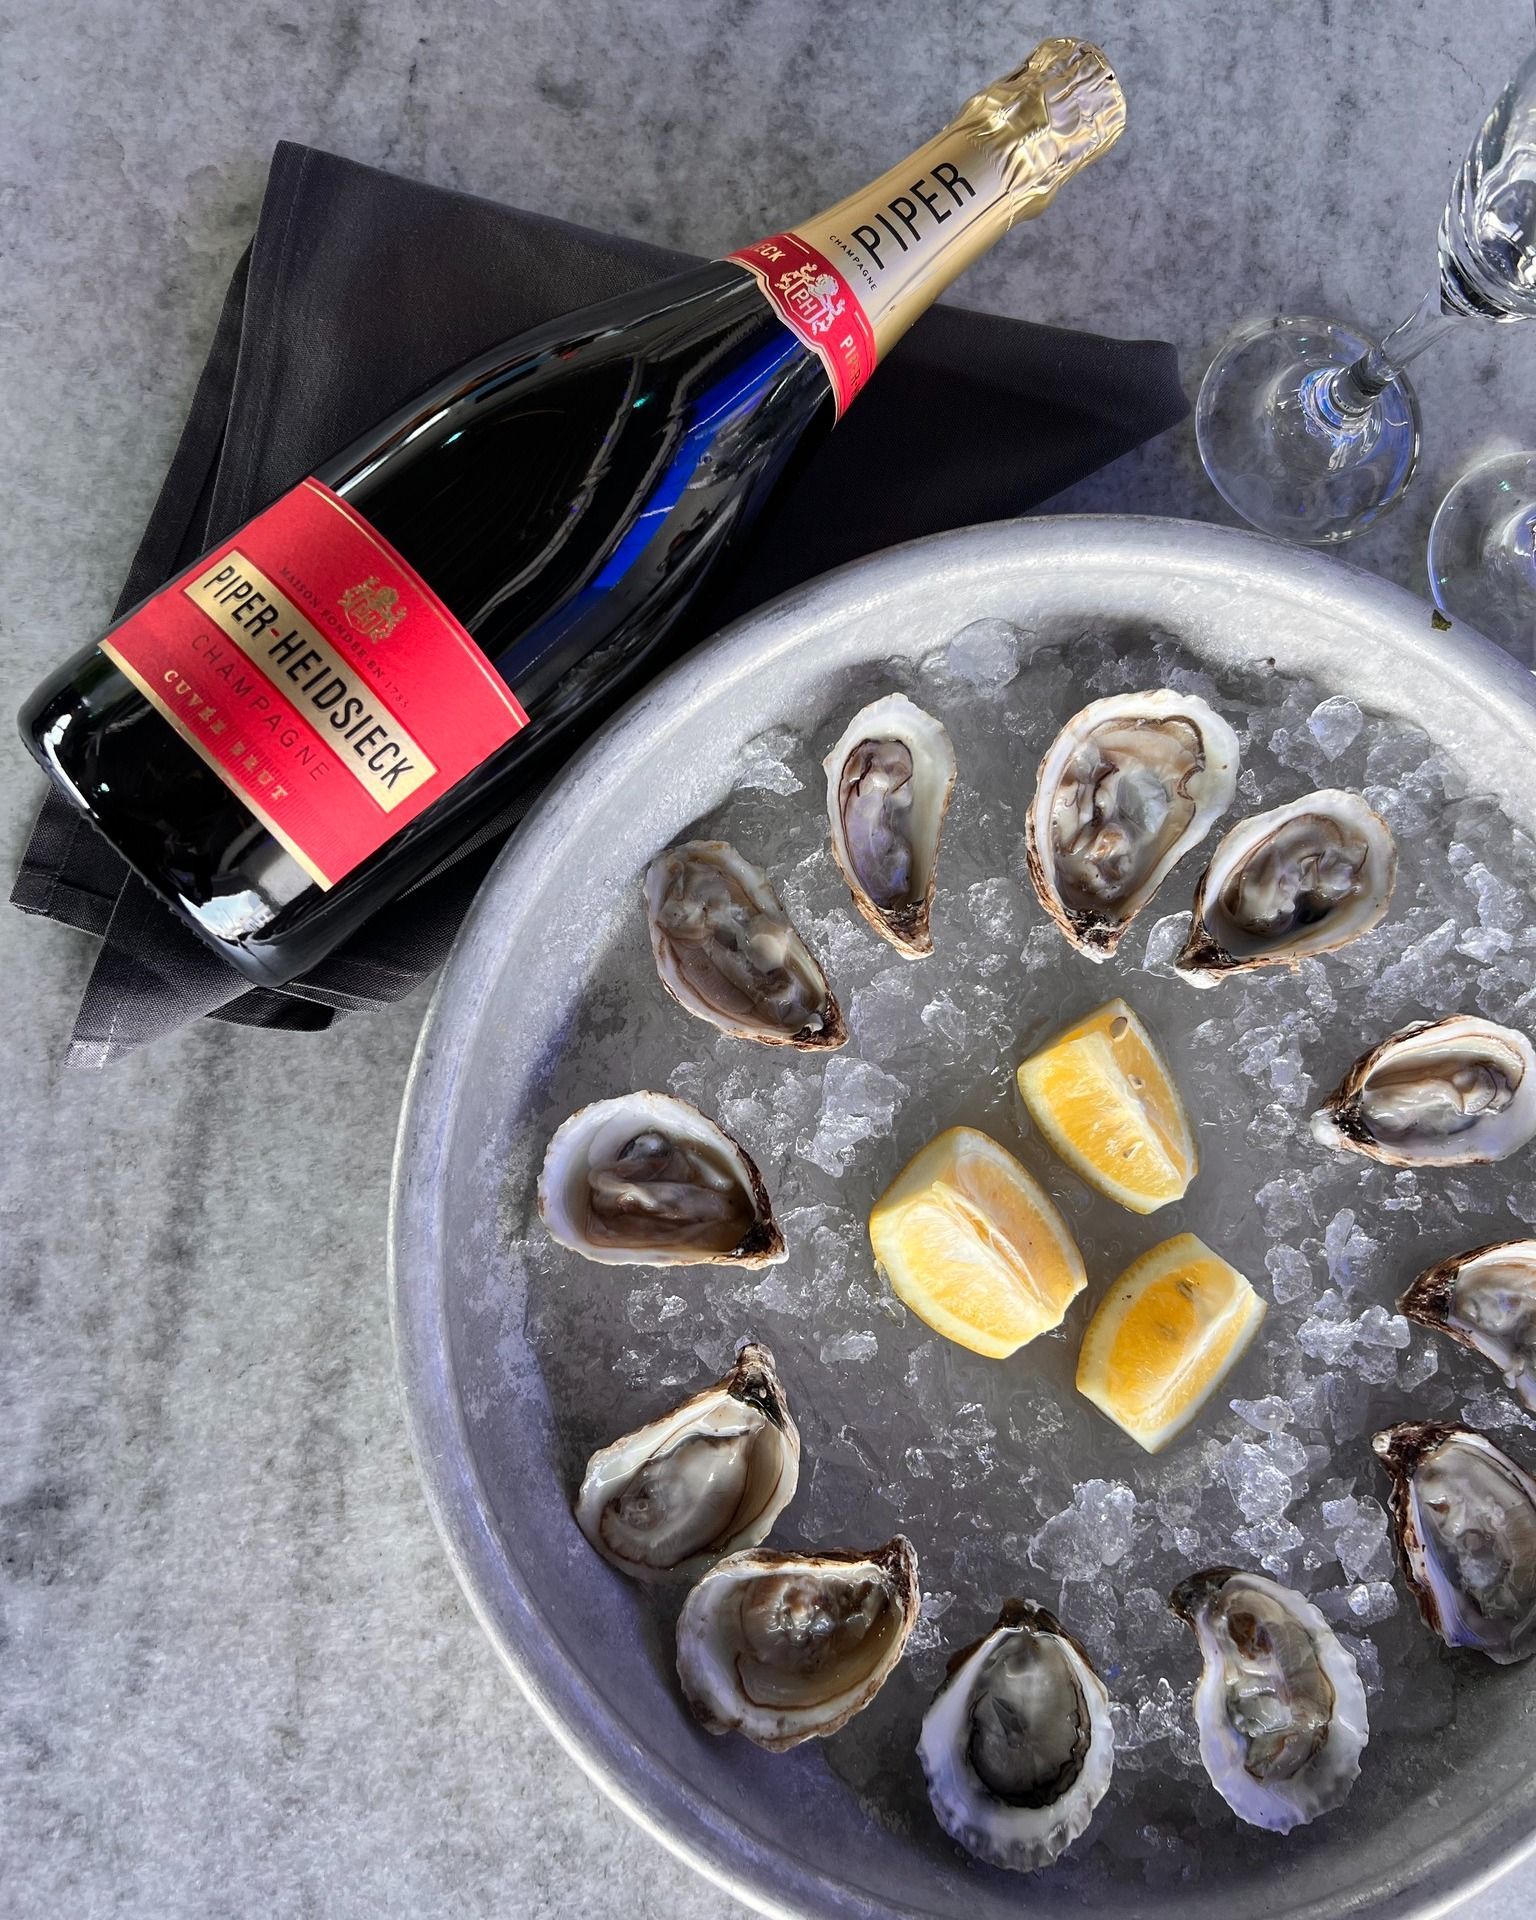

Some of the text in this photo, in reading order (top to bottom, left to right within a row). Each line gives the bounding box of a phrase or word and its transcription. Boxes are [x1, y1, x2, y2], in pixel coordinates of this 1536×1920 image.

[829, 235, 877, 291] CHAMPAGNE
[851, 162, 976, 270] PIPER
[280, 567, 320, 608] MAISON
[192, 633, 330, 782] CHAMPAGNE
[204, 565, 414, 789] PIPER-HEIDSIECK
